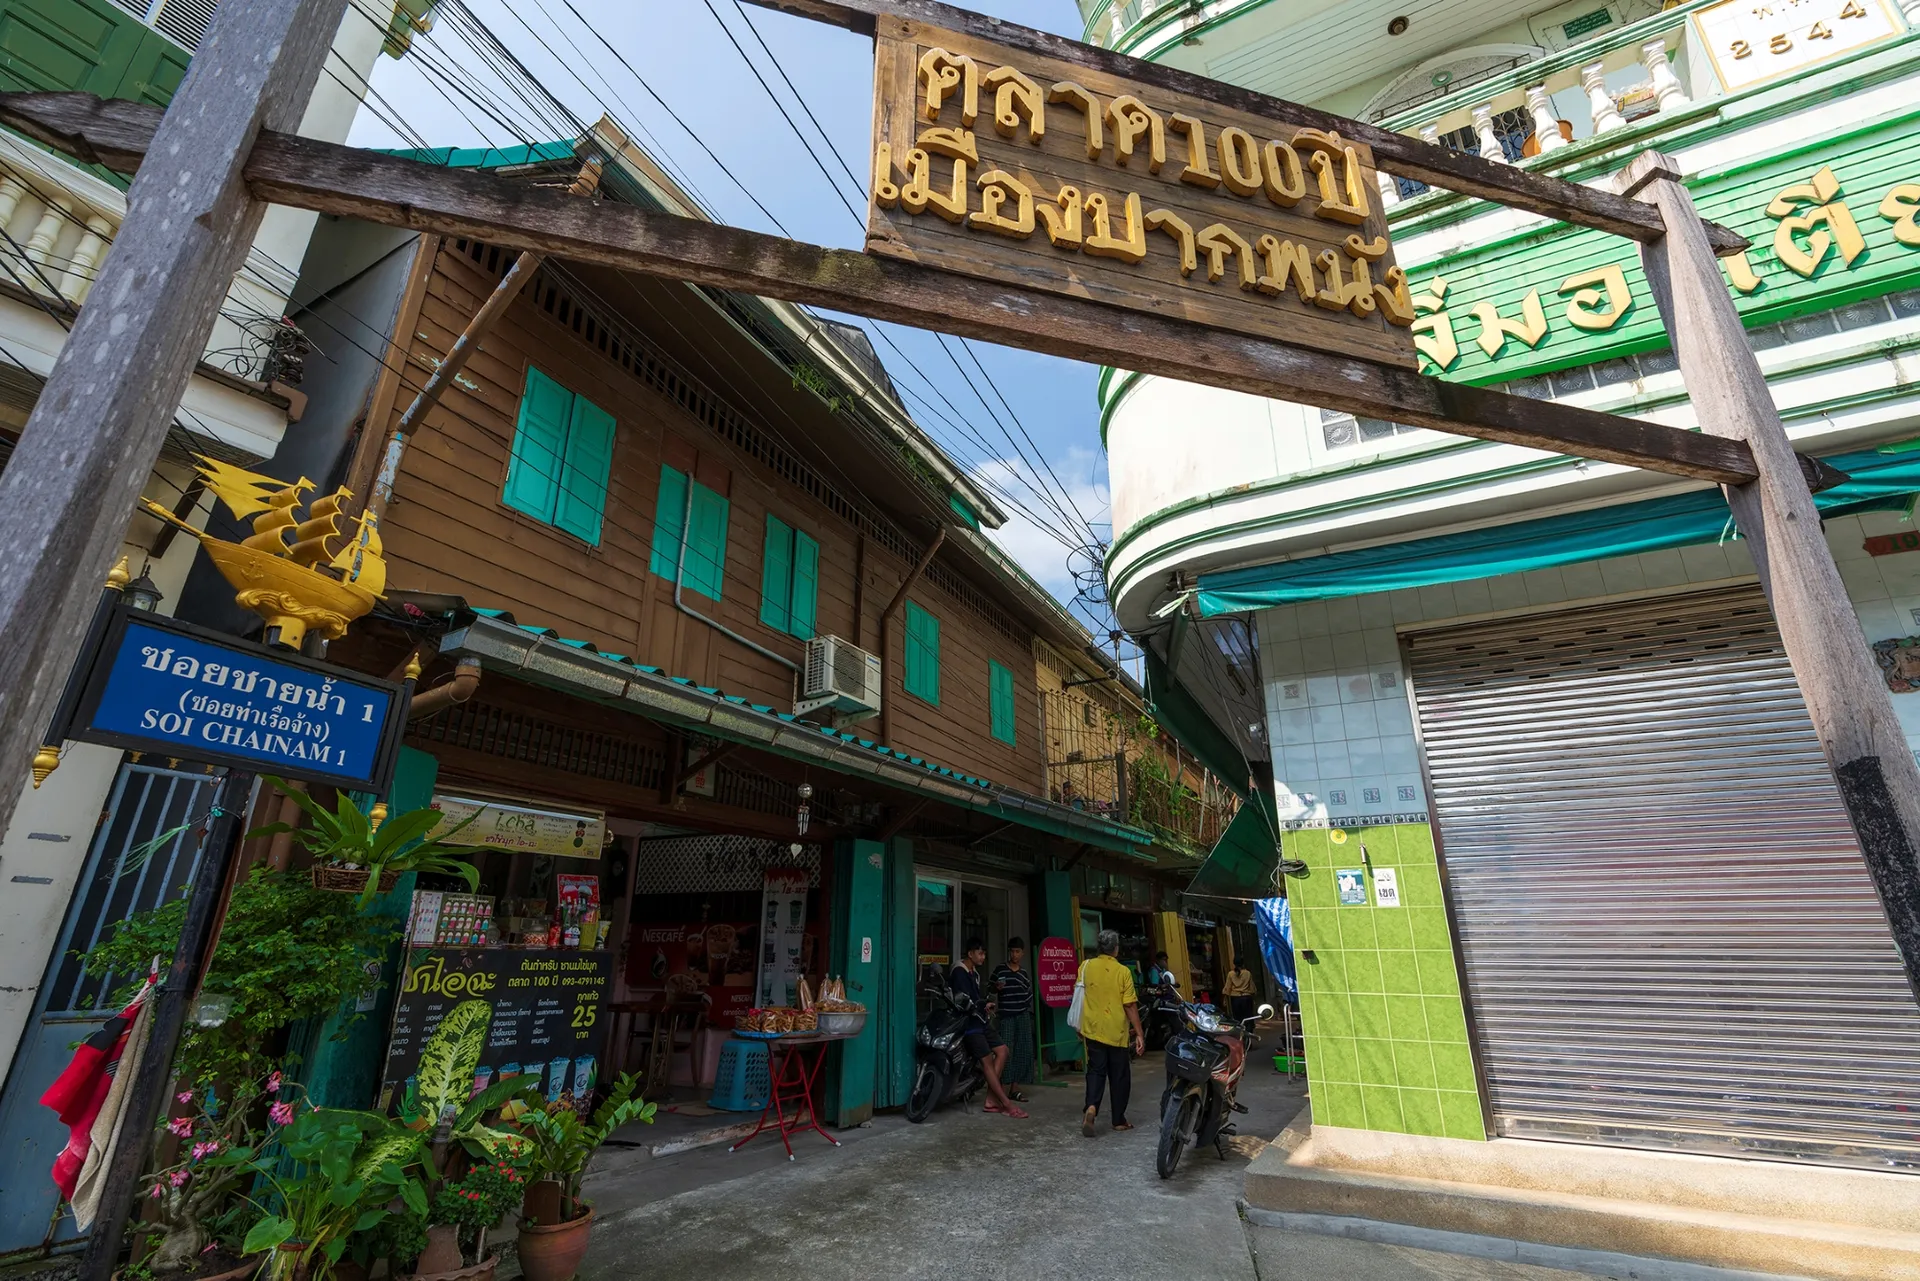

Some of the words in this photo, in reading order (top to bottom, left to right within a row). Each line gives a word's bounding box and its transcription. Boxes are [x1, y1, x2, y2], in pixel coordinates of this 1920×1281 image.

[875, 127, 1415, 327] เมืองปากพนัง
[141, 645, 346, 717] ซอยชายน้ำ
[361, 703, 374, 723] 1
[179, 688, 331, 744] (ซอยท่าเรือจ้าง)
[140, 708, 195, 737] SOI
[202, 721, 332, 764] CHAINAM
[336, 749, 346, 766] 1
[641, 924, 686, 943] NESCAFÉ
[508, 977, 530, 987] ตลาด
[533, 976, 550, 986] 100
[551, 974, 559, 986] ปี
[577, 990, 599, 1003] ทุกแก้ว
[571, 1005, 597, 1028] 25
[575, 1031, 588, 1040] บาท
